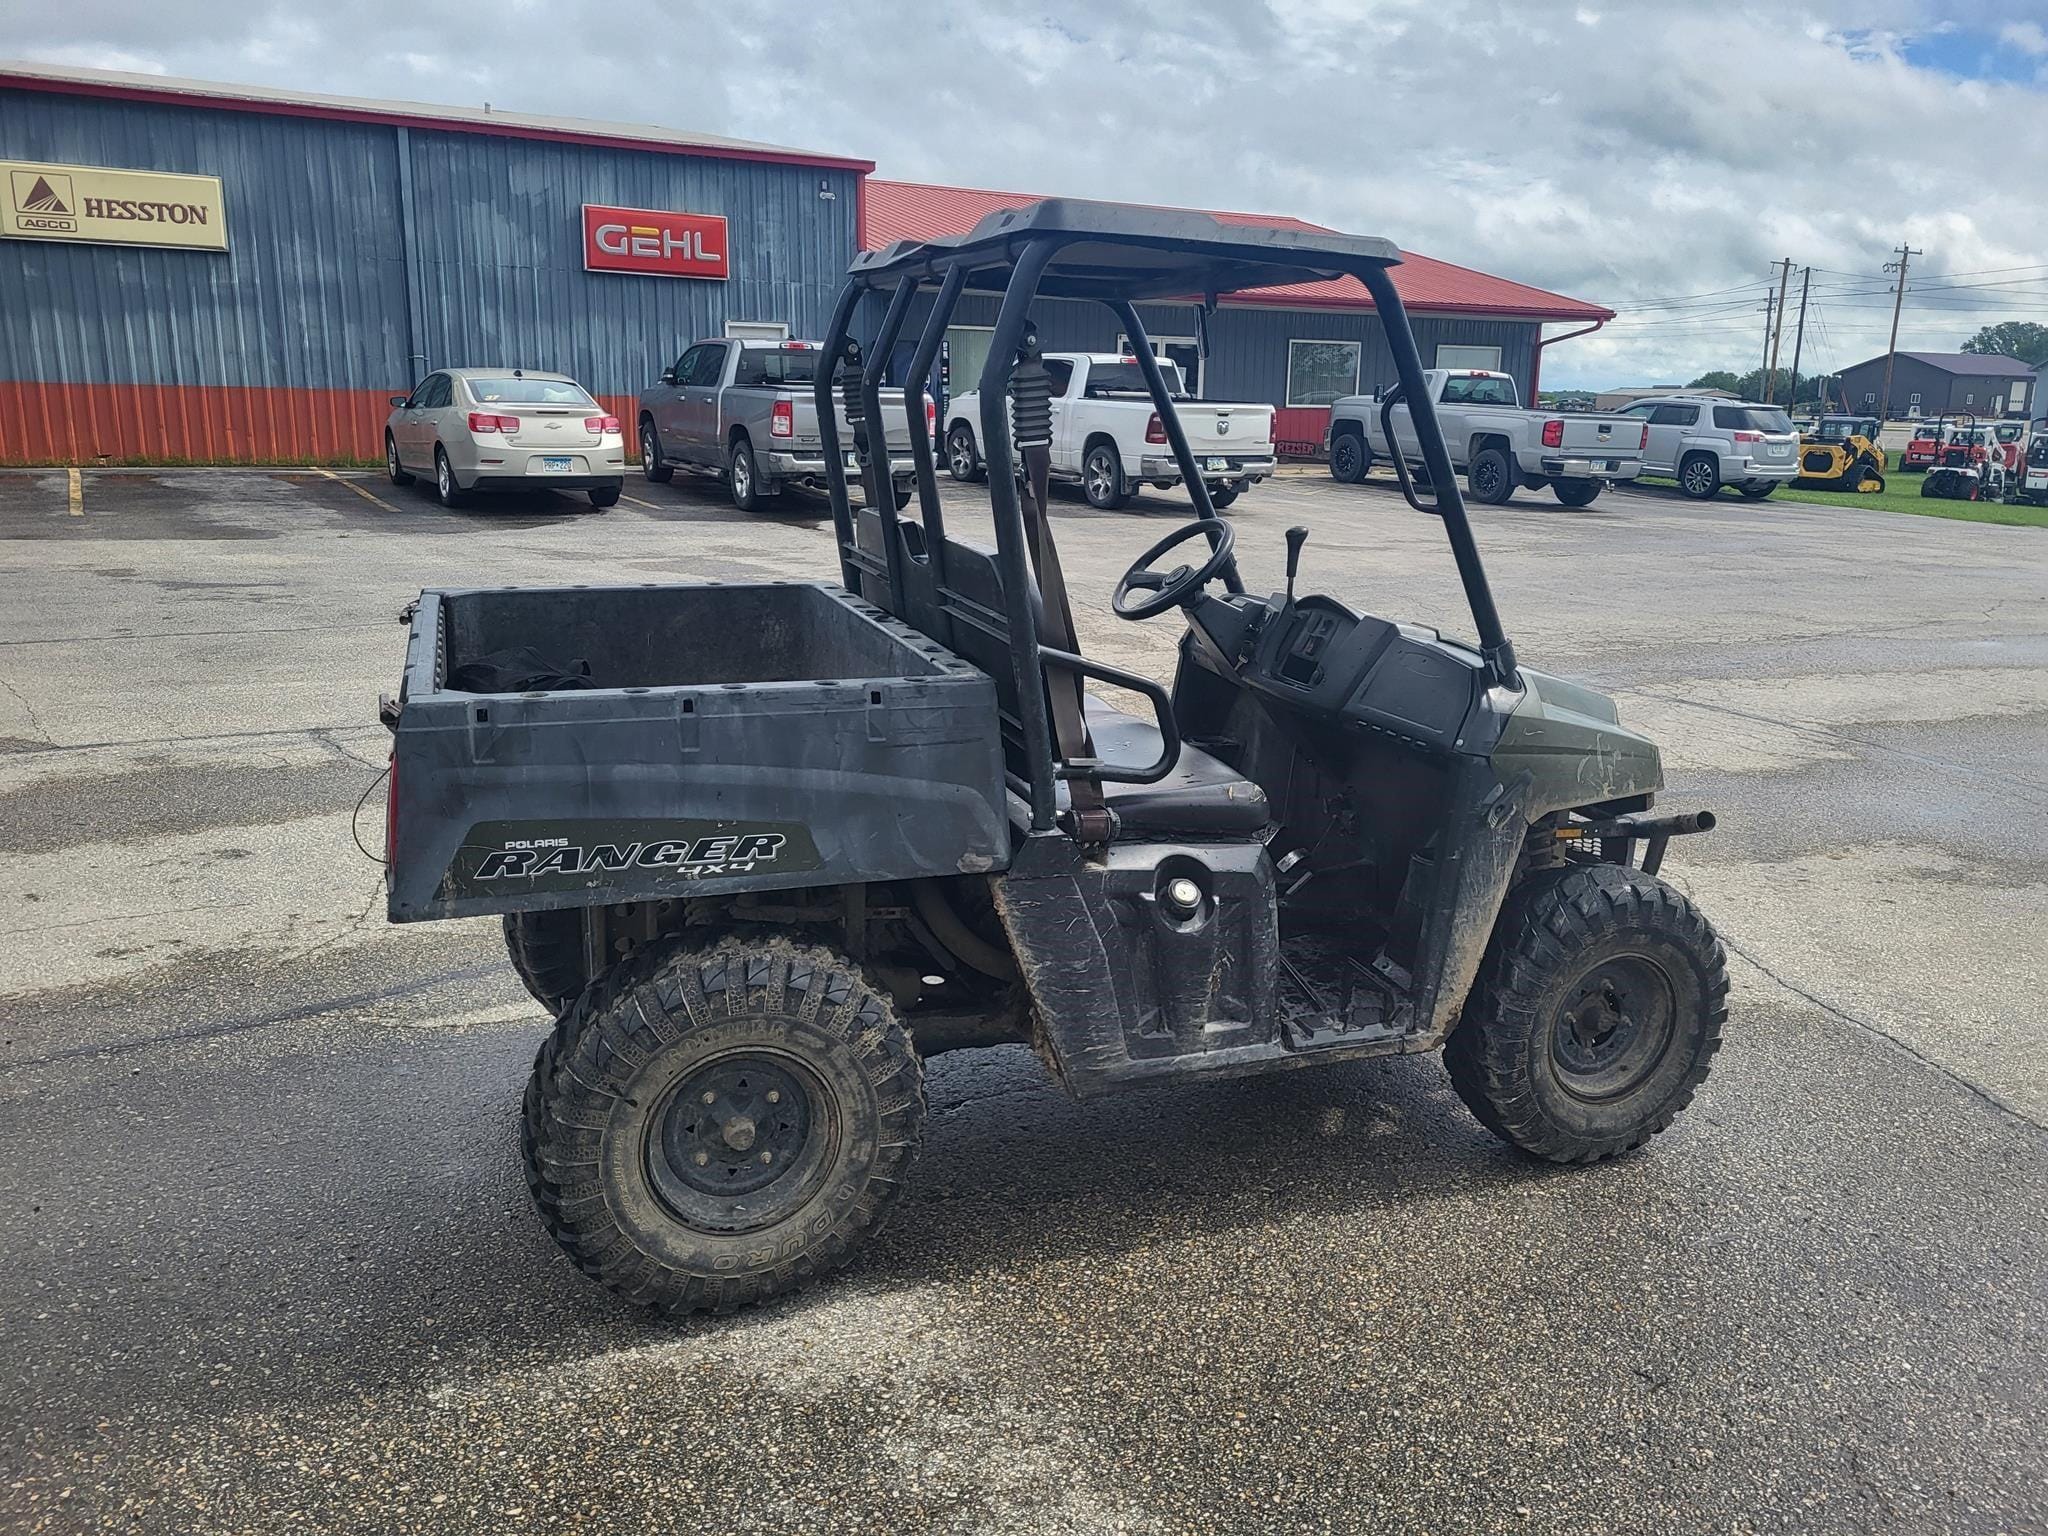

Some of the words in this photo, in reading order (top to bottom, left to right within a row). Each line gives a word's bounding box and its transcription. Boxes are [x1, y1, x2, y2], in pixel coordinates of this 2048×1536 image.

[24, 218, 71, 230] AGCO
[84, 197, 208, 225] HESSTON
[595, 224, 721, 261] GEHL
[473, 833, 788, 881] RANGER
[504, 837, 568, 850] POLARIS
[711, 1209, 833, 1270] DURO
